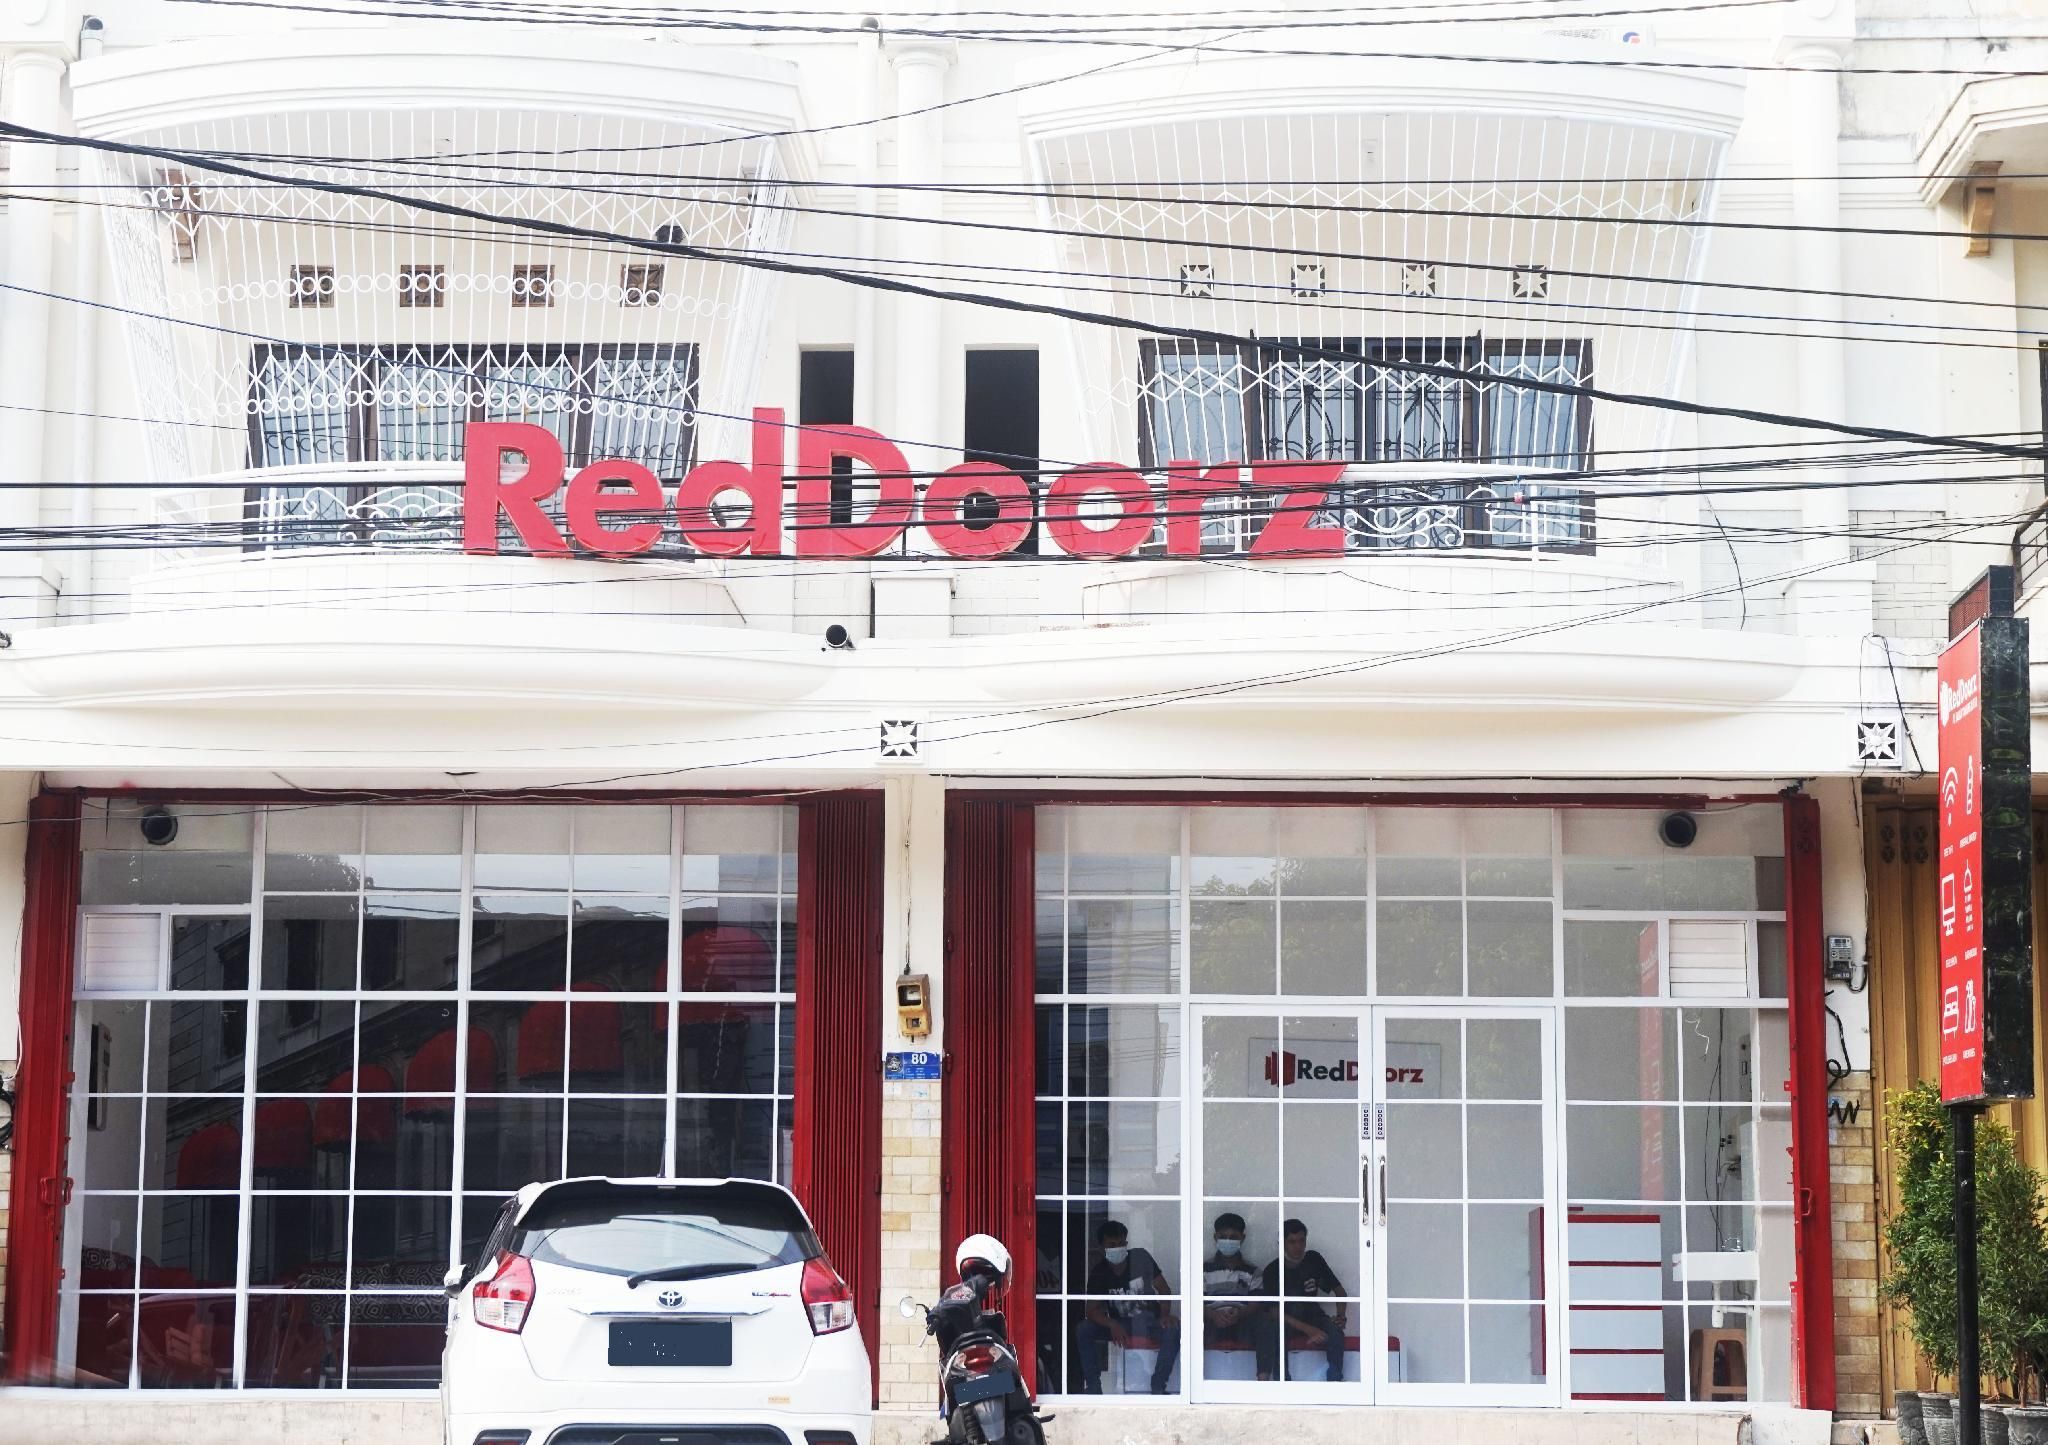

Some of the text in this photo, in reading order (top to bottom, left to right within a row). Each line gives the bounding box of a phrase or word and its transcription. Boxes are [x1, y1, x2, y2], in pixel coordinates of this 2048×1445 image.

[463, 407, 1346, 560] RedDoorz
[911, 1053, 928, 1065] 80
[1297, 1059, 1424, 1083] RedDorz
